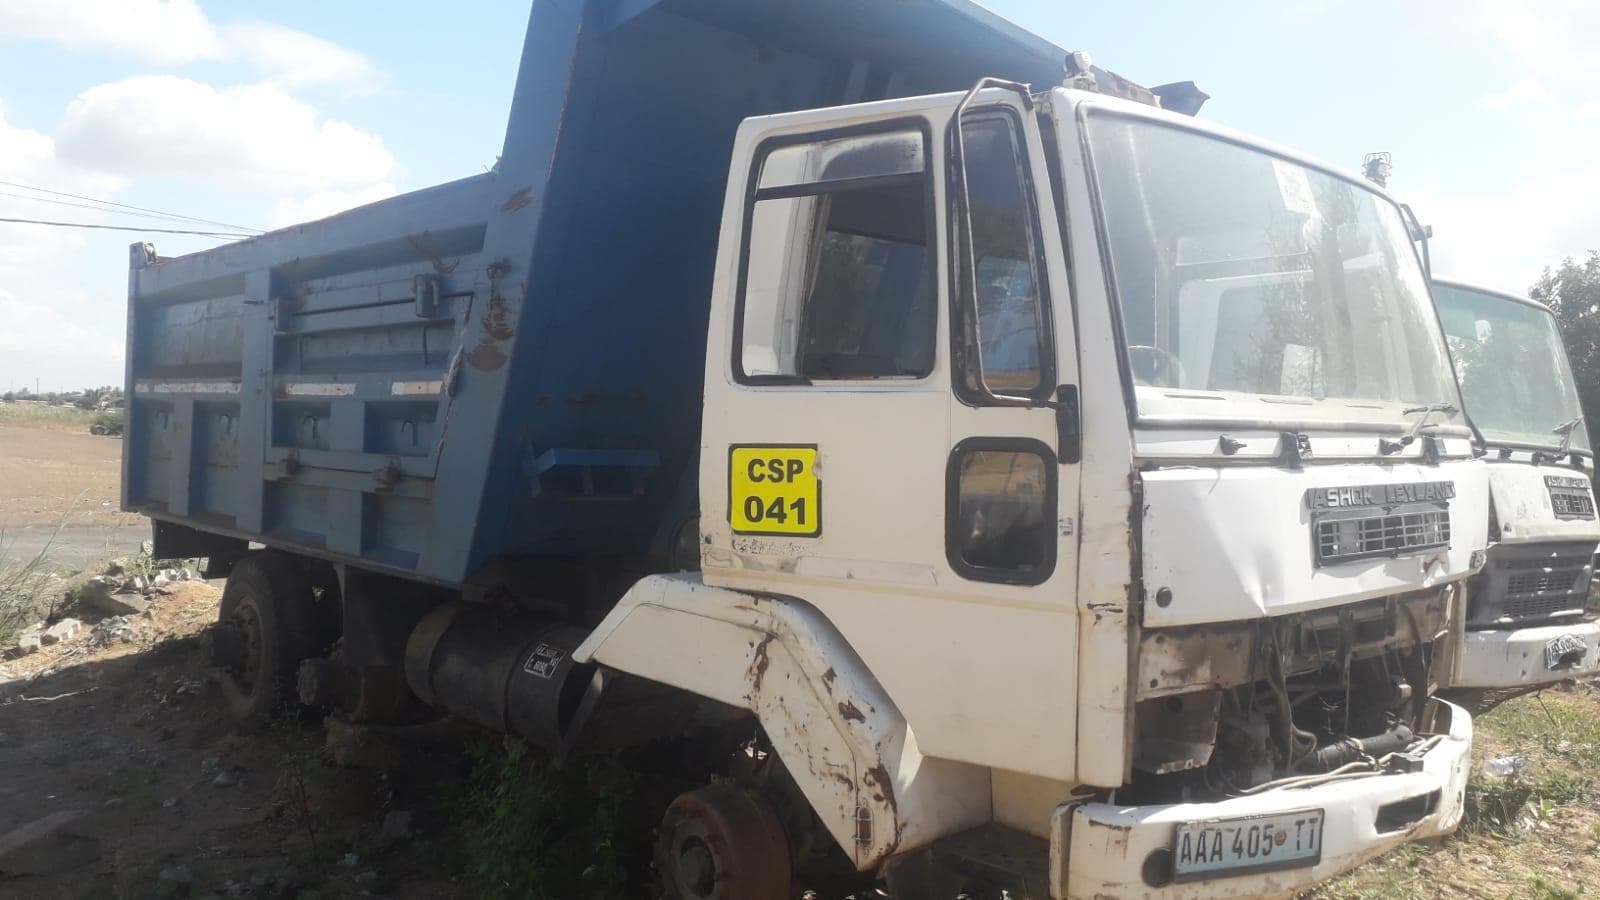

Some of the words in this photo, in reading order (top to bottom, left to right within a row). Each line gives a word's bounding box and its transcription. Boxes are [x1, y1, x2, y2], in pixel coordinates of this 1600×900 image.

[747, 458, 804, 483] CSP
[1312, 487, 1376, 509] ASHOK
[1384, 481, 1456, 504] LEYLAND
[743, 495, 806, 525] 041
[1180, 830, 1223, 865] AAA
[1231, 823, 1274, 860] 405
